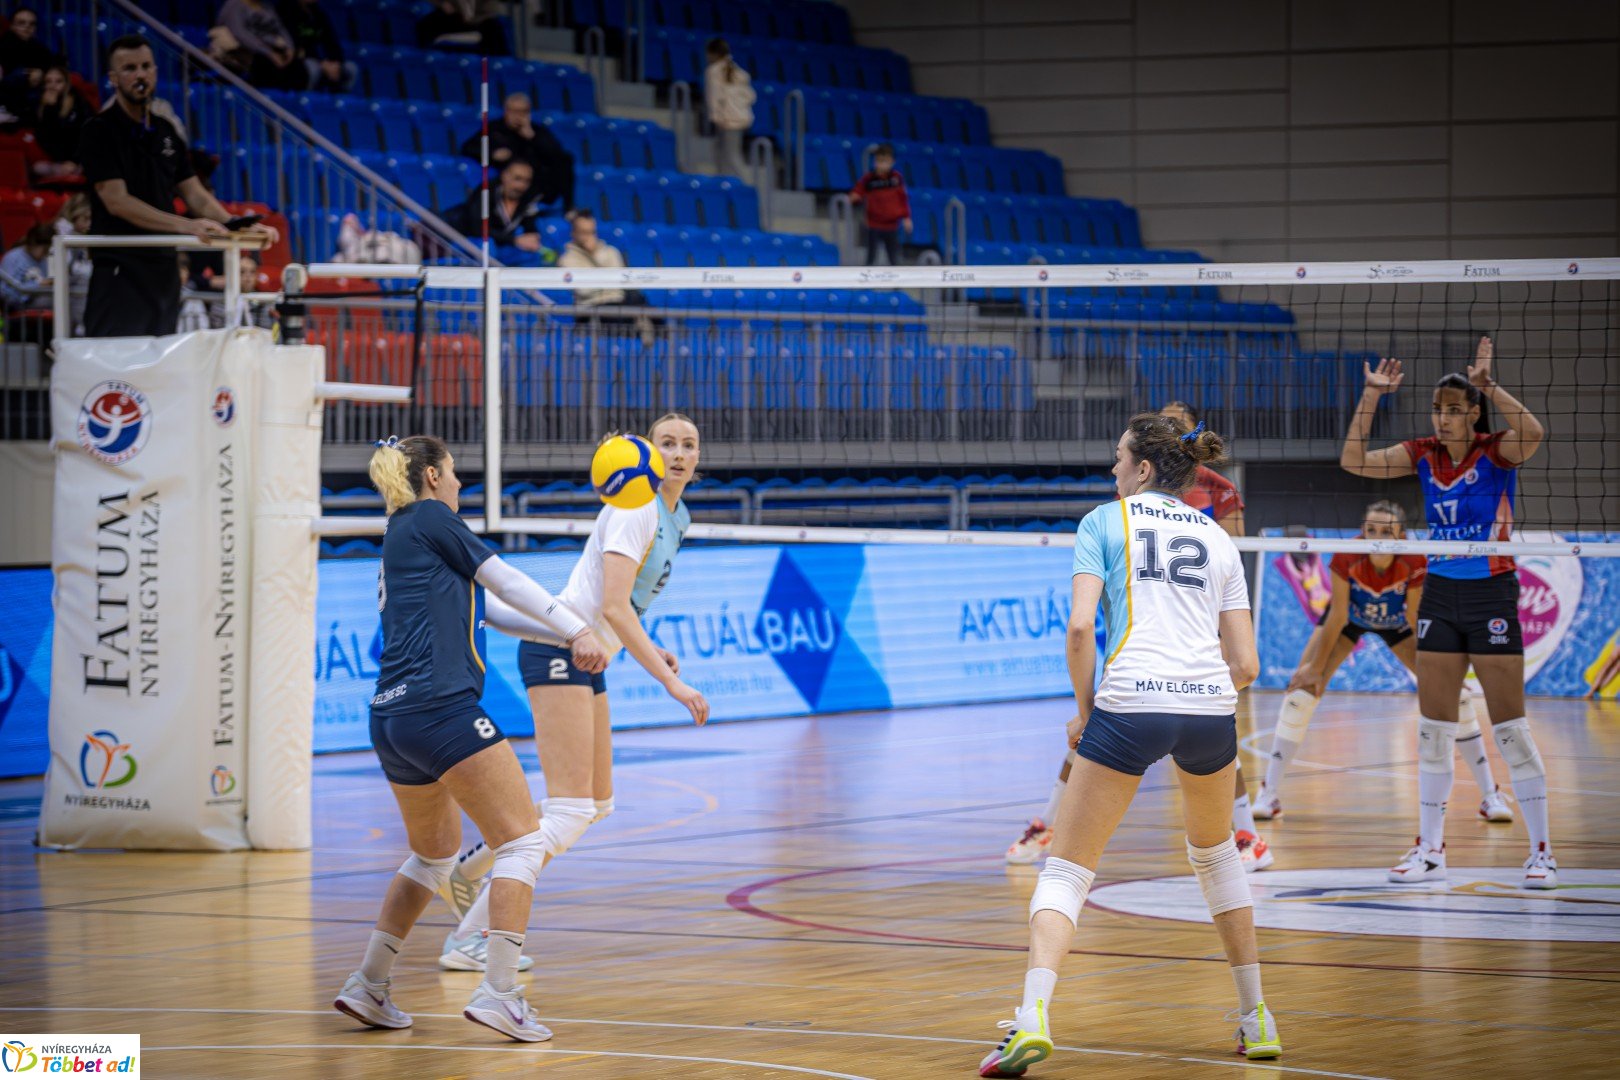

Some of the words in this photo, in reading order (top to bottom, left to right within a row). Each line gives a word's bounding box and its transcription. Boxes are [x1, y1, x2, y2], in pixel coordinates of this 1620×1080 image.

[1464, 264, 1501, 278] FATUM
[1433, 499, 1459, 525] 17
[1135, 528, 1210, 592] 12
[80, 489, 130, 696] FATUM
[137, 491, 159, 697] NYÍREGYHÁZA
[549, 658, 569, 680] 2
[1136, 677, 1163, 692] MÁV
[1167, 680, 1206, 695] ELŐRE
[1208, 684, 1222, 696] SC
[473, 717, 496, 739] 8
[65, 794, 151, 811] NYÍREGYHÁZA
